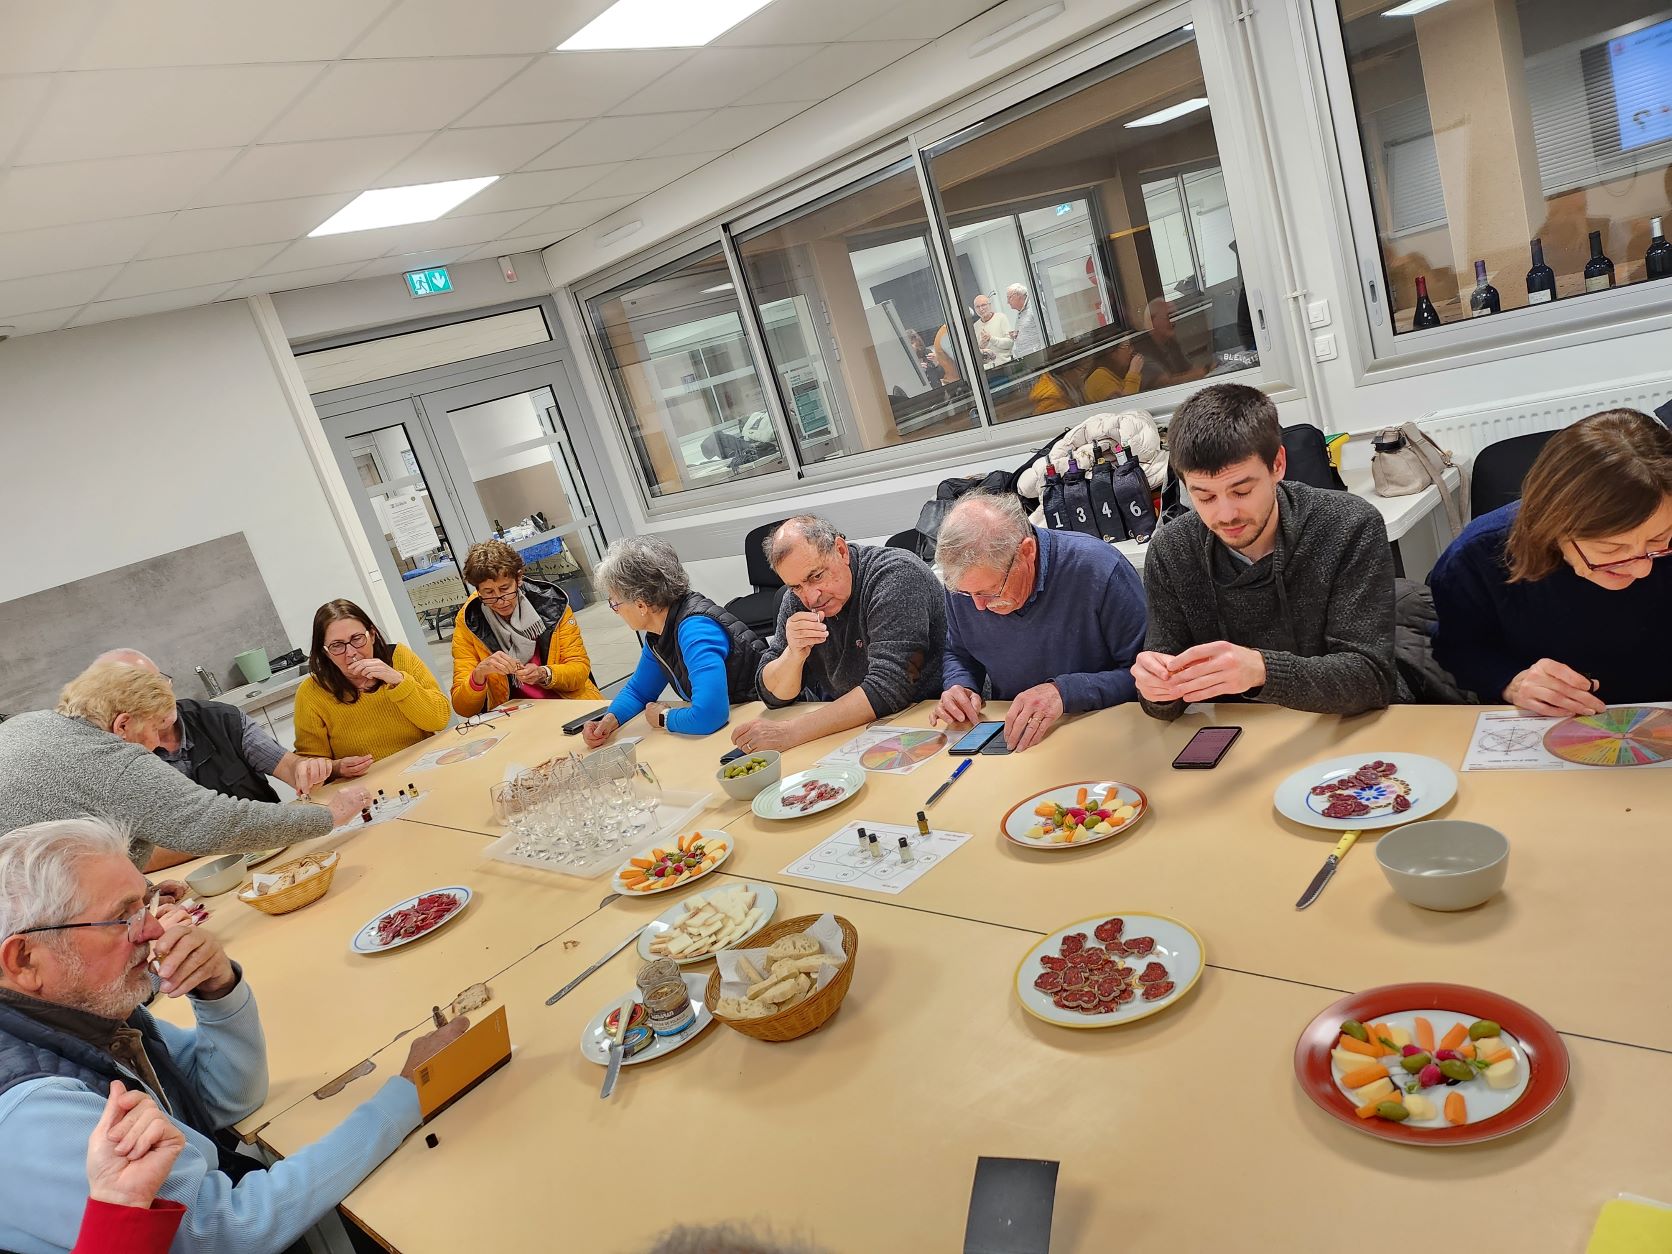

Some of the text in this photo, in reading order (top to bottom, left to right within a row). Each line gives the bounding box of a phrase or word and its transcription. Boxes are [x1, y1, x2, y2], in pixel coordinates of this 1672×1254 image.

[1076, 507, 1087, 523] 3
[1102, 502, 1112, 518] 4
[1129, 501, 1142, 517] 6
[1053, 512, 1064, 528] 1
